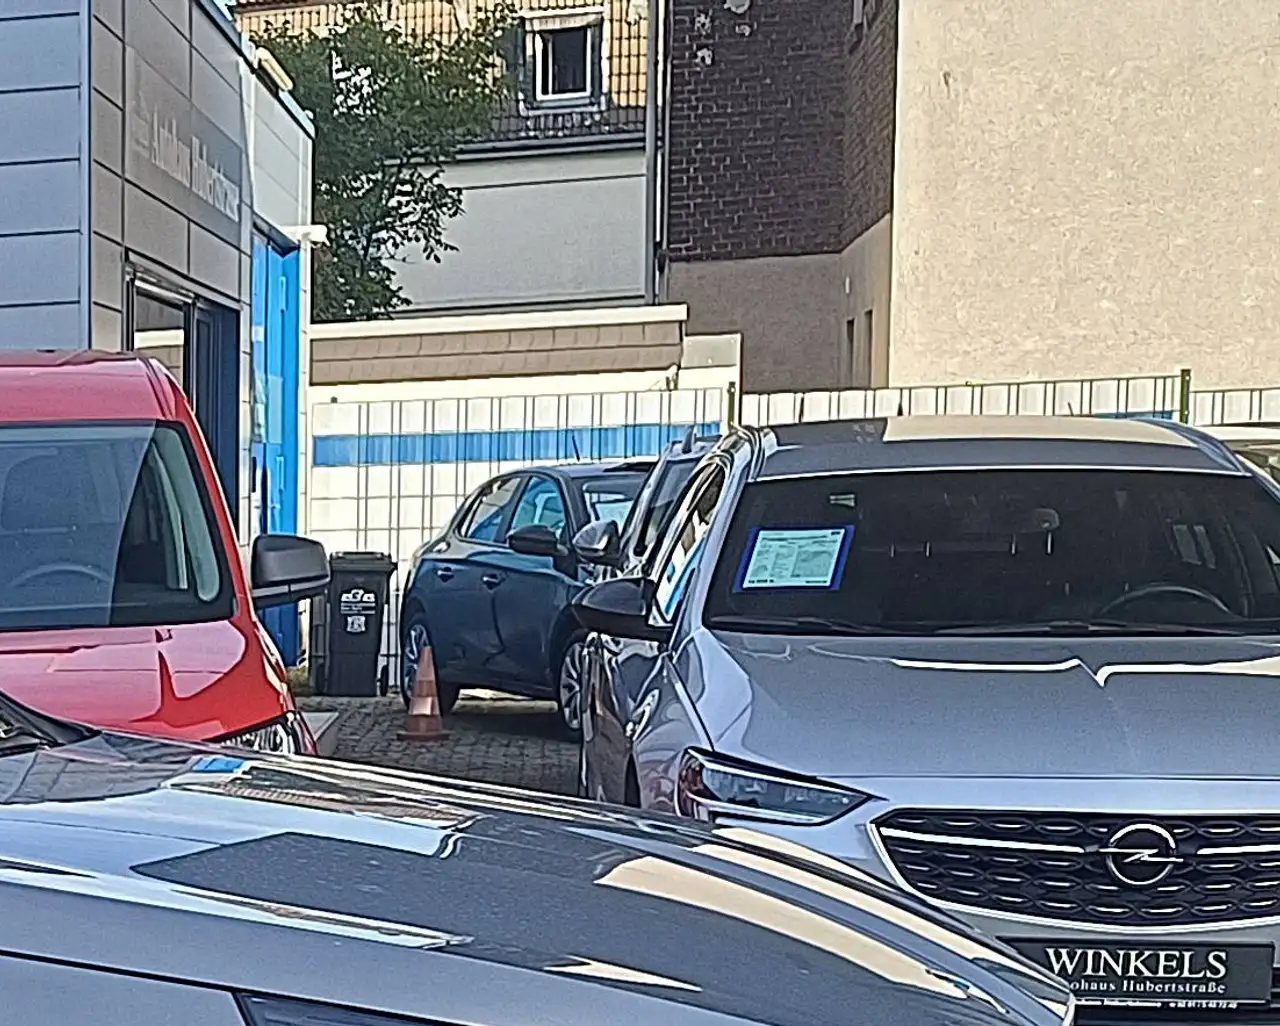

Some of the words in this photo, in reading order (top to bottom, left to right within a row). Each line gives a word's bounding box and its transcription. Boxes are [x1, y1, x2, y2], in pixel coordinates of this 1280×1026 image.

[1046, 946, 1227, 979] WINKELS
[1069, 980, 1117, 991] ohaus
[1122, 979, 1227, 994] Hubertstraße
